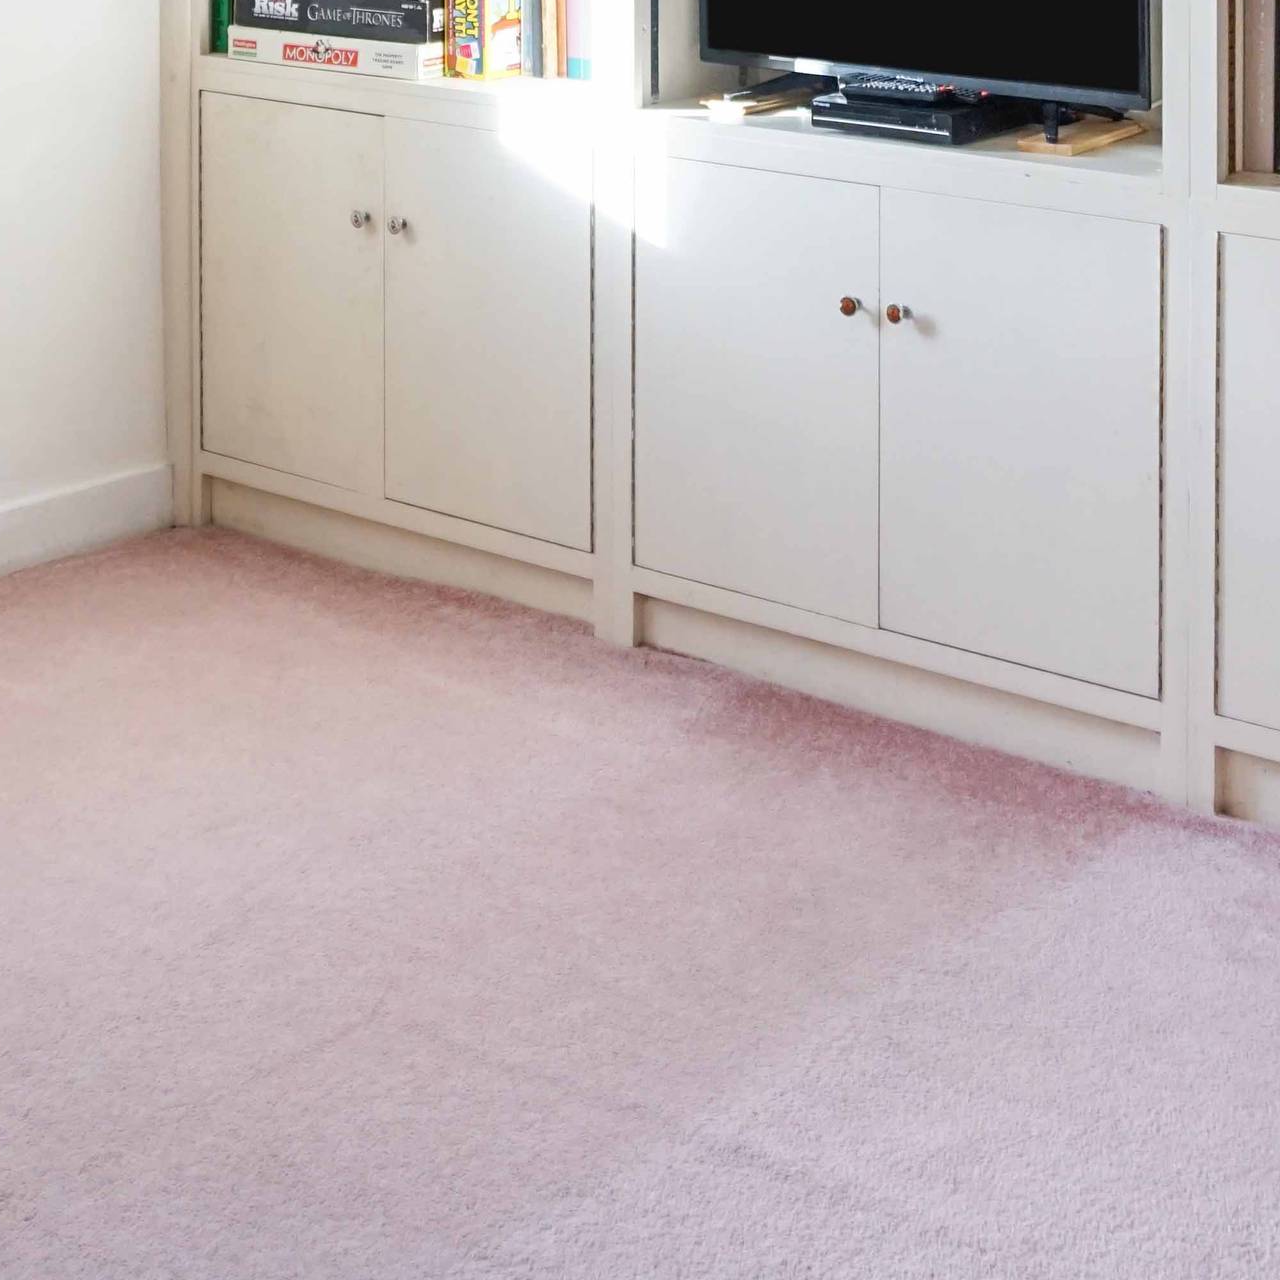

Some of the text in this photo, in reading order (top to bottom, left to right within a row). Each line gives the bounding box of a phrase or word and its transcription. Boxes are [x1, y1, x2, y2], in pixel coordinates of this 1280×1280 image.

[307, 4, 405, 27] GAME THRONES
[285, 46, 356, 65] MONOPOLY
